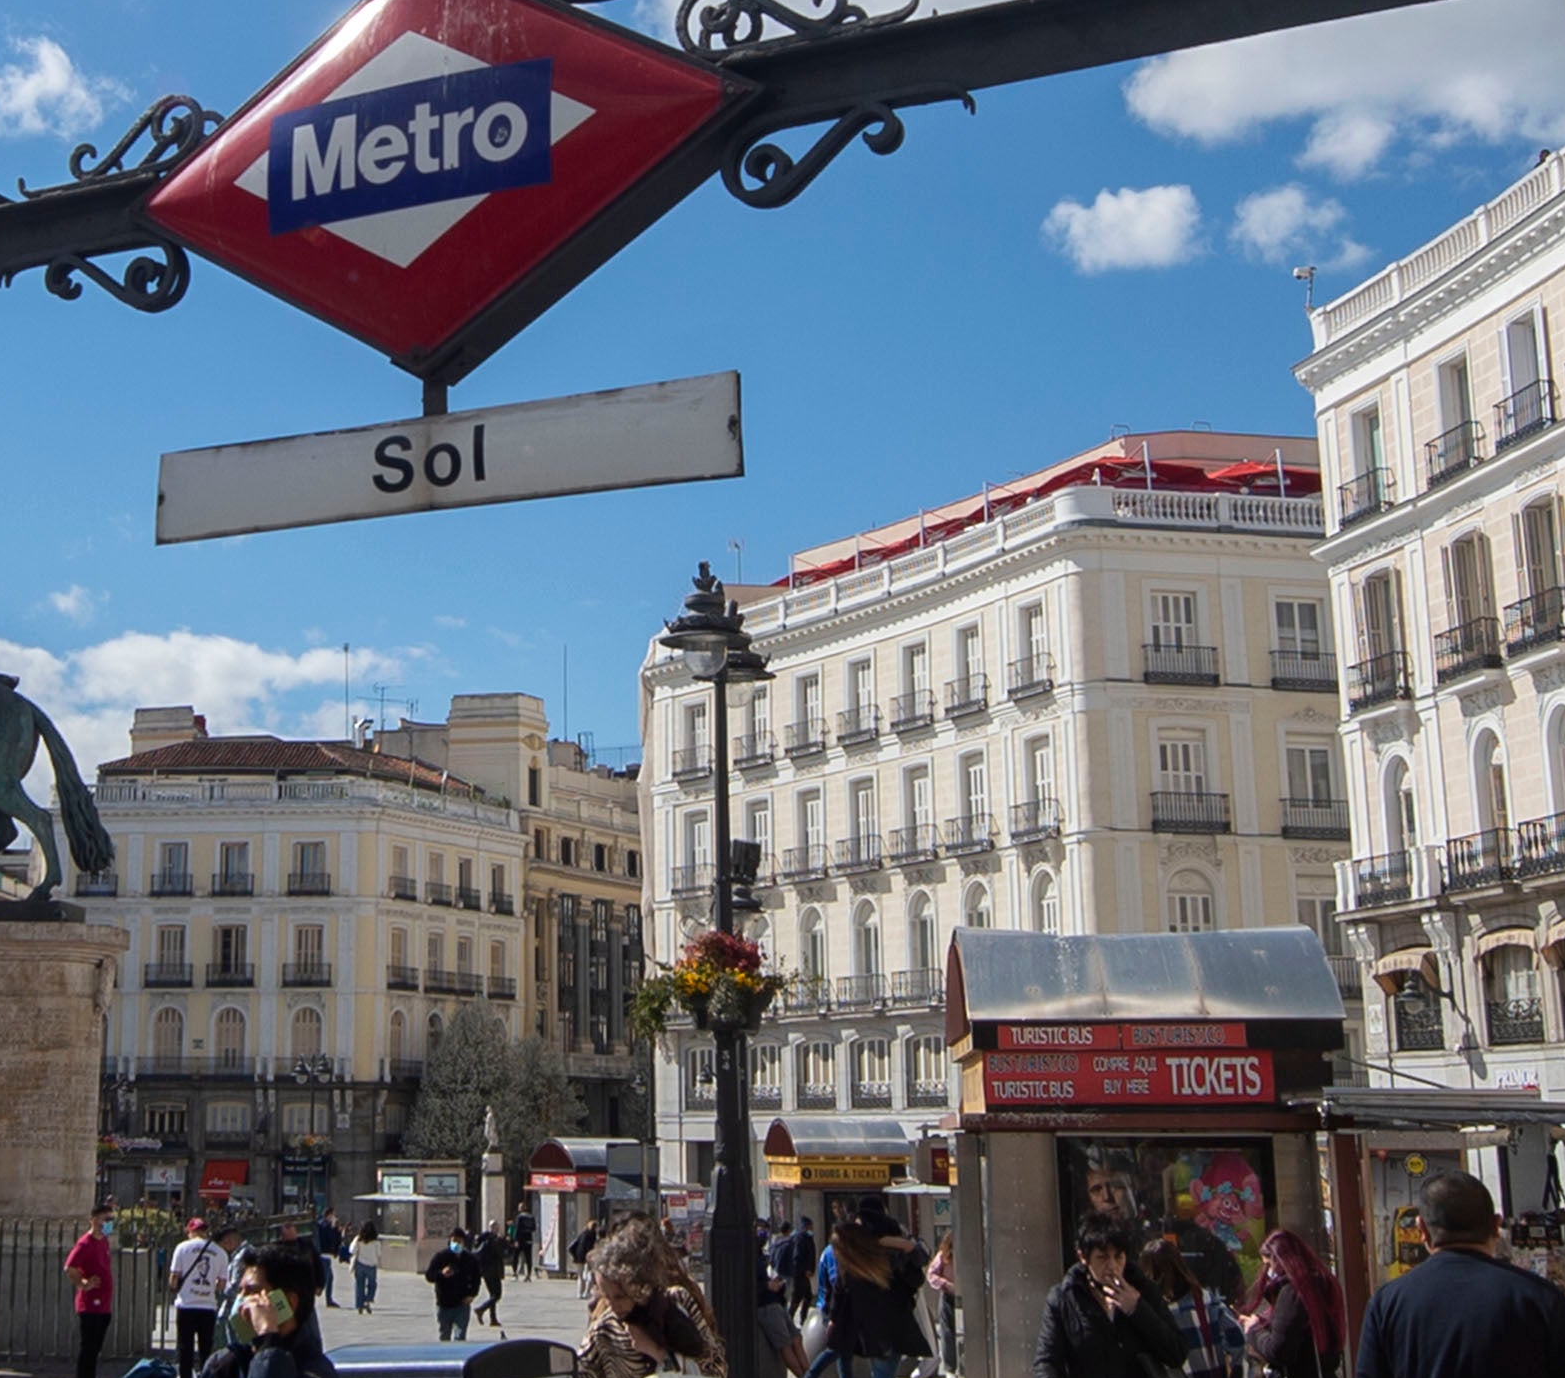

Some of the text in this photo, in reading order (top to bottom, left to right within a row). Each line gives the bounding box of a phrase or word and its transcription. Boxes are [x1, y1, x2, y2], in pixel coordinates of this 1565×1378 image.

[291, 100, 528, 202] Metro
[372, 425, 486, 494] Sol
[1011, 1026, 1093, 1045] TURISTIC BUS
[1132, 1025, 1156, 1044] BUS
[988, 1054, 1011, 1073] BUS
[1093, 1056, 1129, 1072] COMPRE
[1166, 1055, 1262, 1096] TICKETS
[992, 1080, 1075, 1099] TURISTIC BUS
[1104, 1079, 1150, 1095] BUY HERE
[852, 1166, 888, 1179] TICKETS
